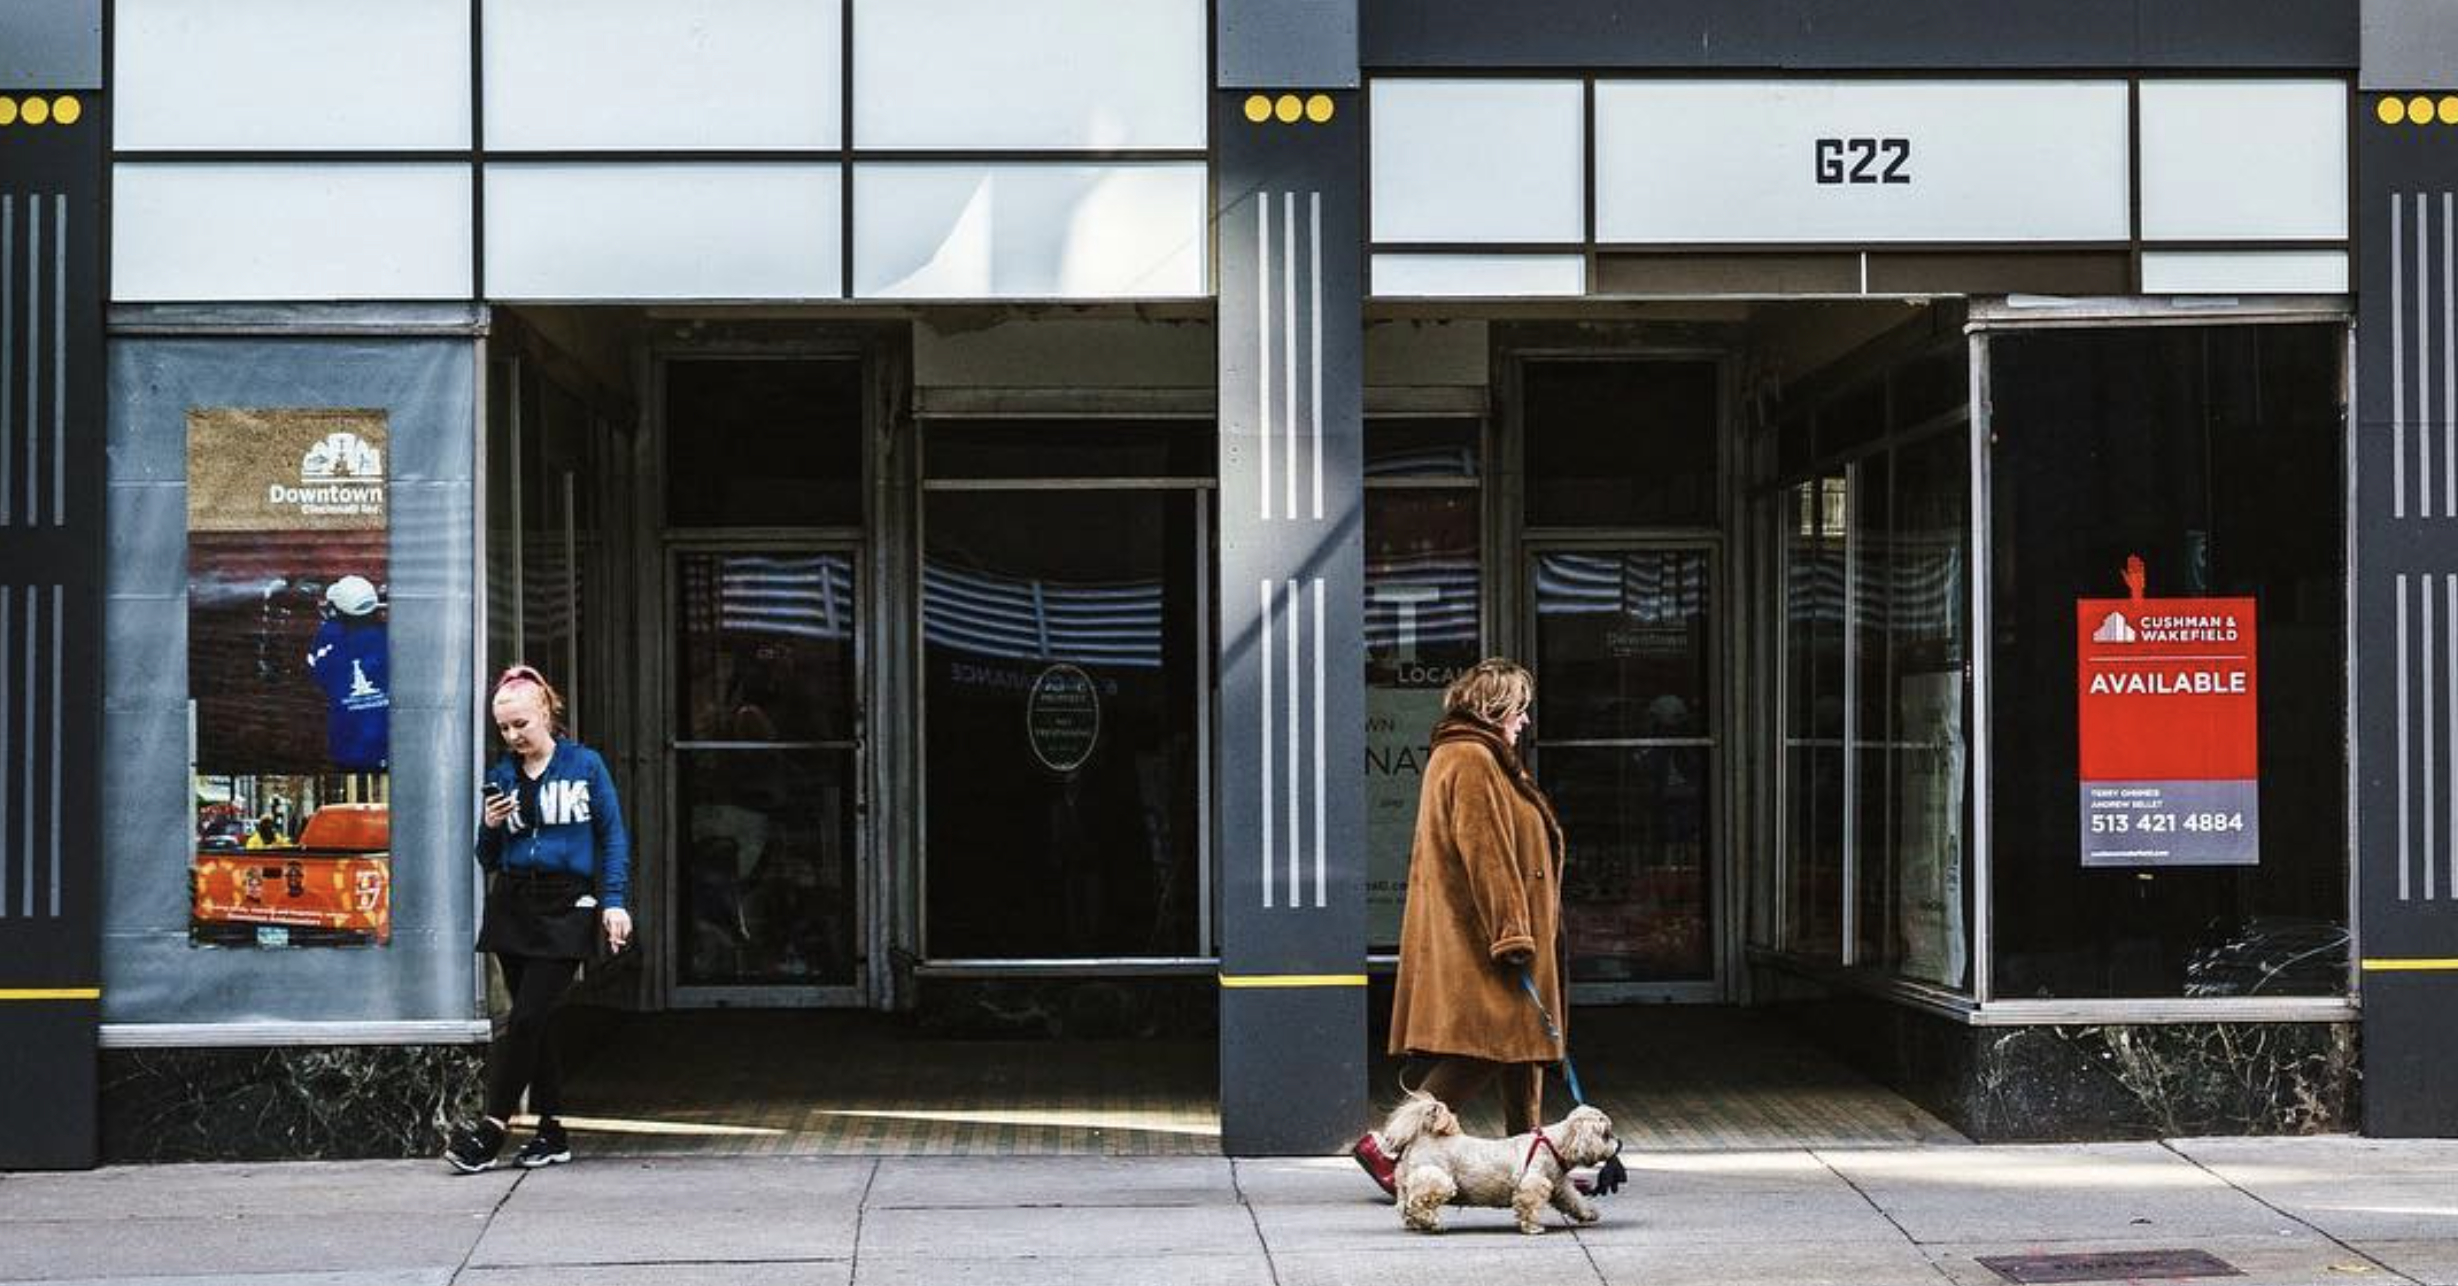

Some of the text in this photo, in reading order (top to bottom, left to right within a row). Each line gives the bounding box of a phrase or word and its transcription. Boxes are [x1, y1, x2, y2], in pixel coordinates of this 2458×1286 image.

[1815, 138, 1911, 184] G22
[269, 484, 383, 503] Downtown
[2140, 616, 2236, 629] CUSHMAN &
[2140, 629, 2239, 642] WAKEFIELD
[2089, 671, 2247, 694] AVAILABLE
[2091, 813, 2244, 832] 513 421 4884
